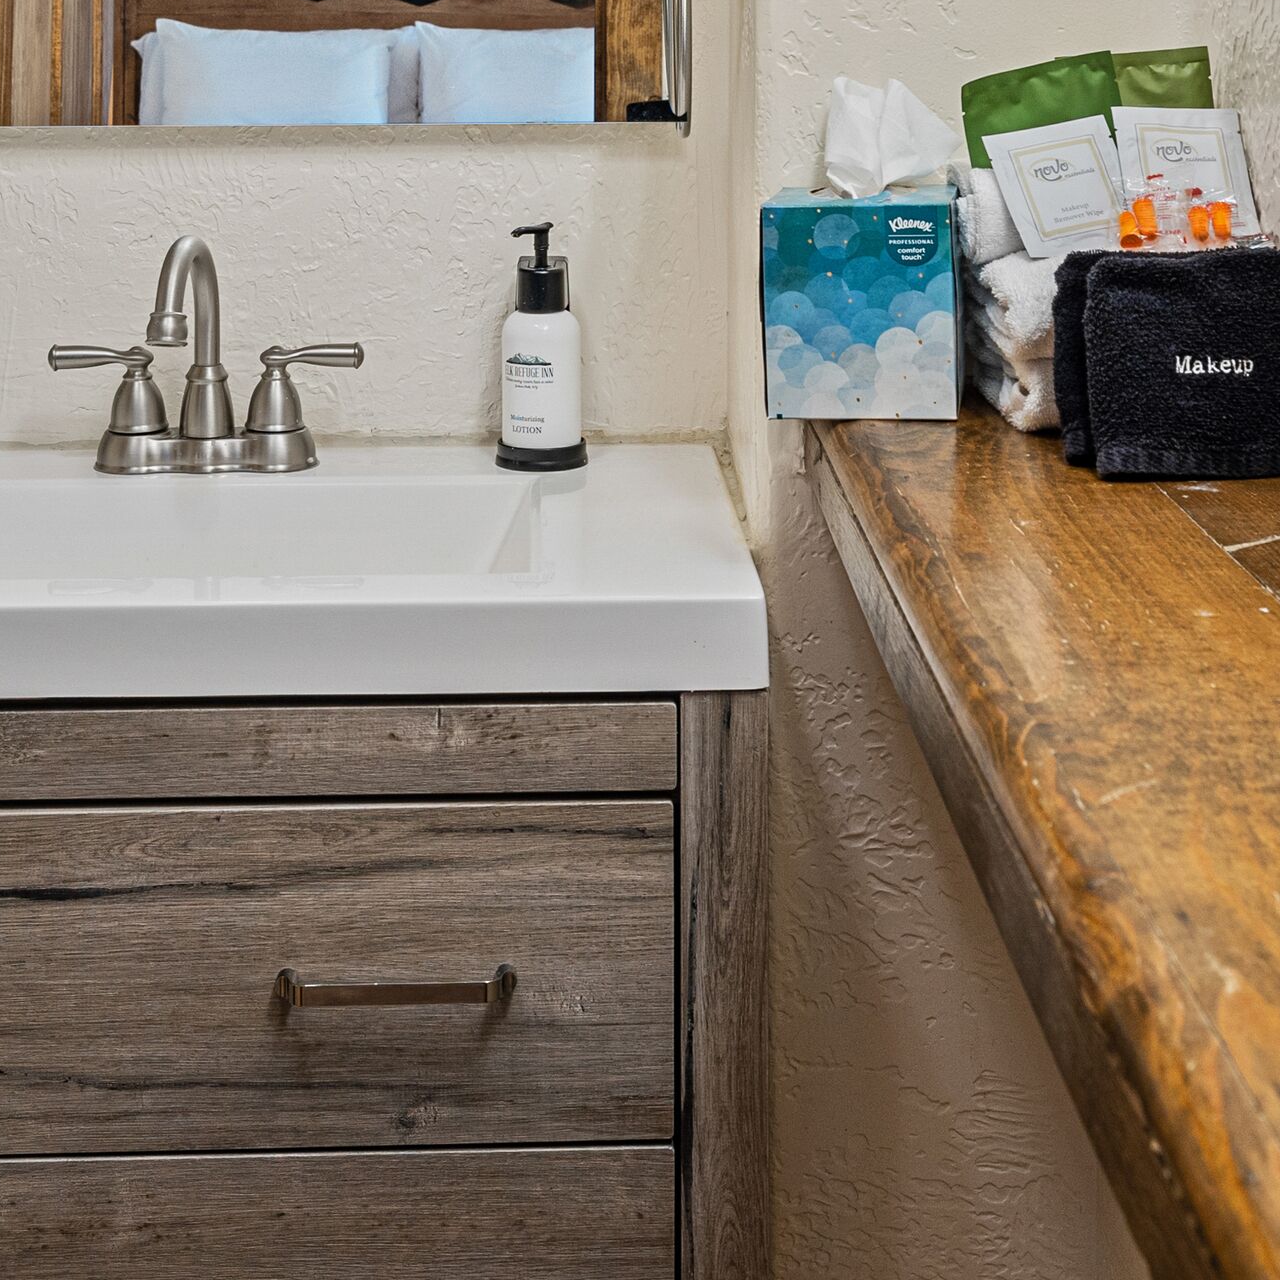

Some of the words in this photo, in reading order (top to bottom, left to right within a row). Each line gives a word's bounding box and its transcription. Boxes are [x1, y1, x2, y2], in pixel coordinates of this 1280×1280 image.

[1156, 140, 1192, 162] novo
[1033, 158, 1069, 182] novo
[1060, 202, 1090, 213] Makeup
[1053, 212, 1085, 223] Remover
[1086, 209, 1105, 218] Wipe
[888, 216, 933, 232] Kleenex
[504, 365, 514, 376] ELK
[514, 366, 540, 378] REFUGE
[541, 367, 554, 378] INN
[1175, 355, 1254, 377] Makeup
[510, 414, 545, 423] Moisturizing
[512, 425, 542, 434] LOTION
